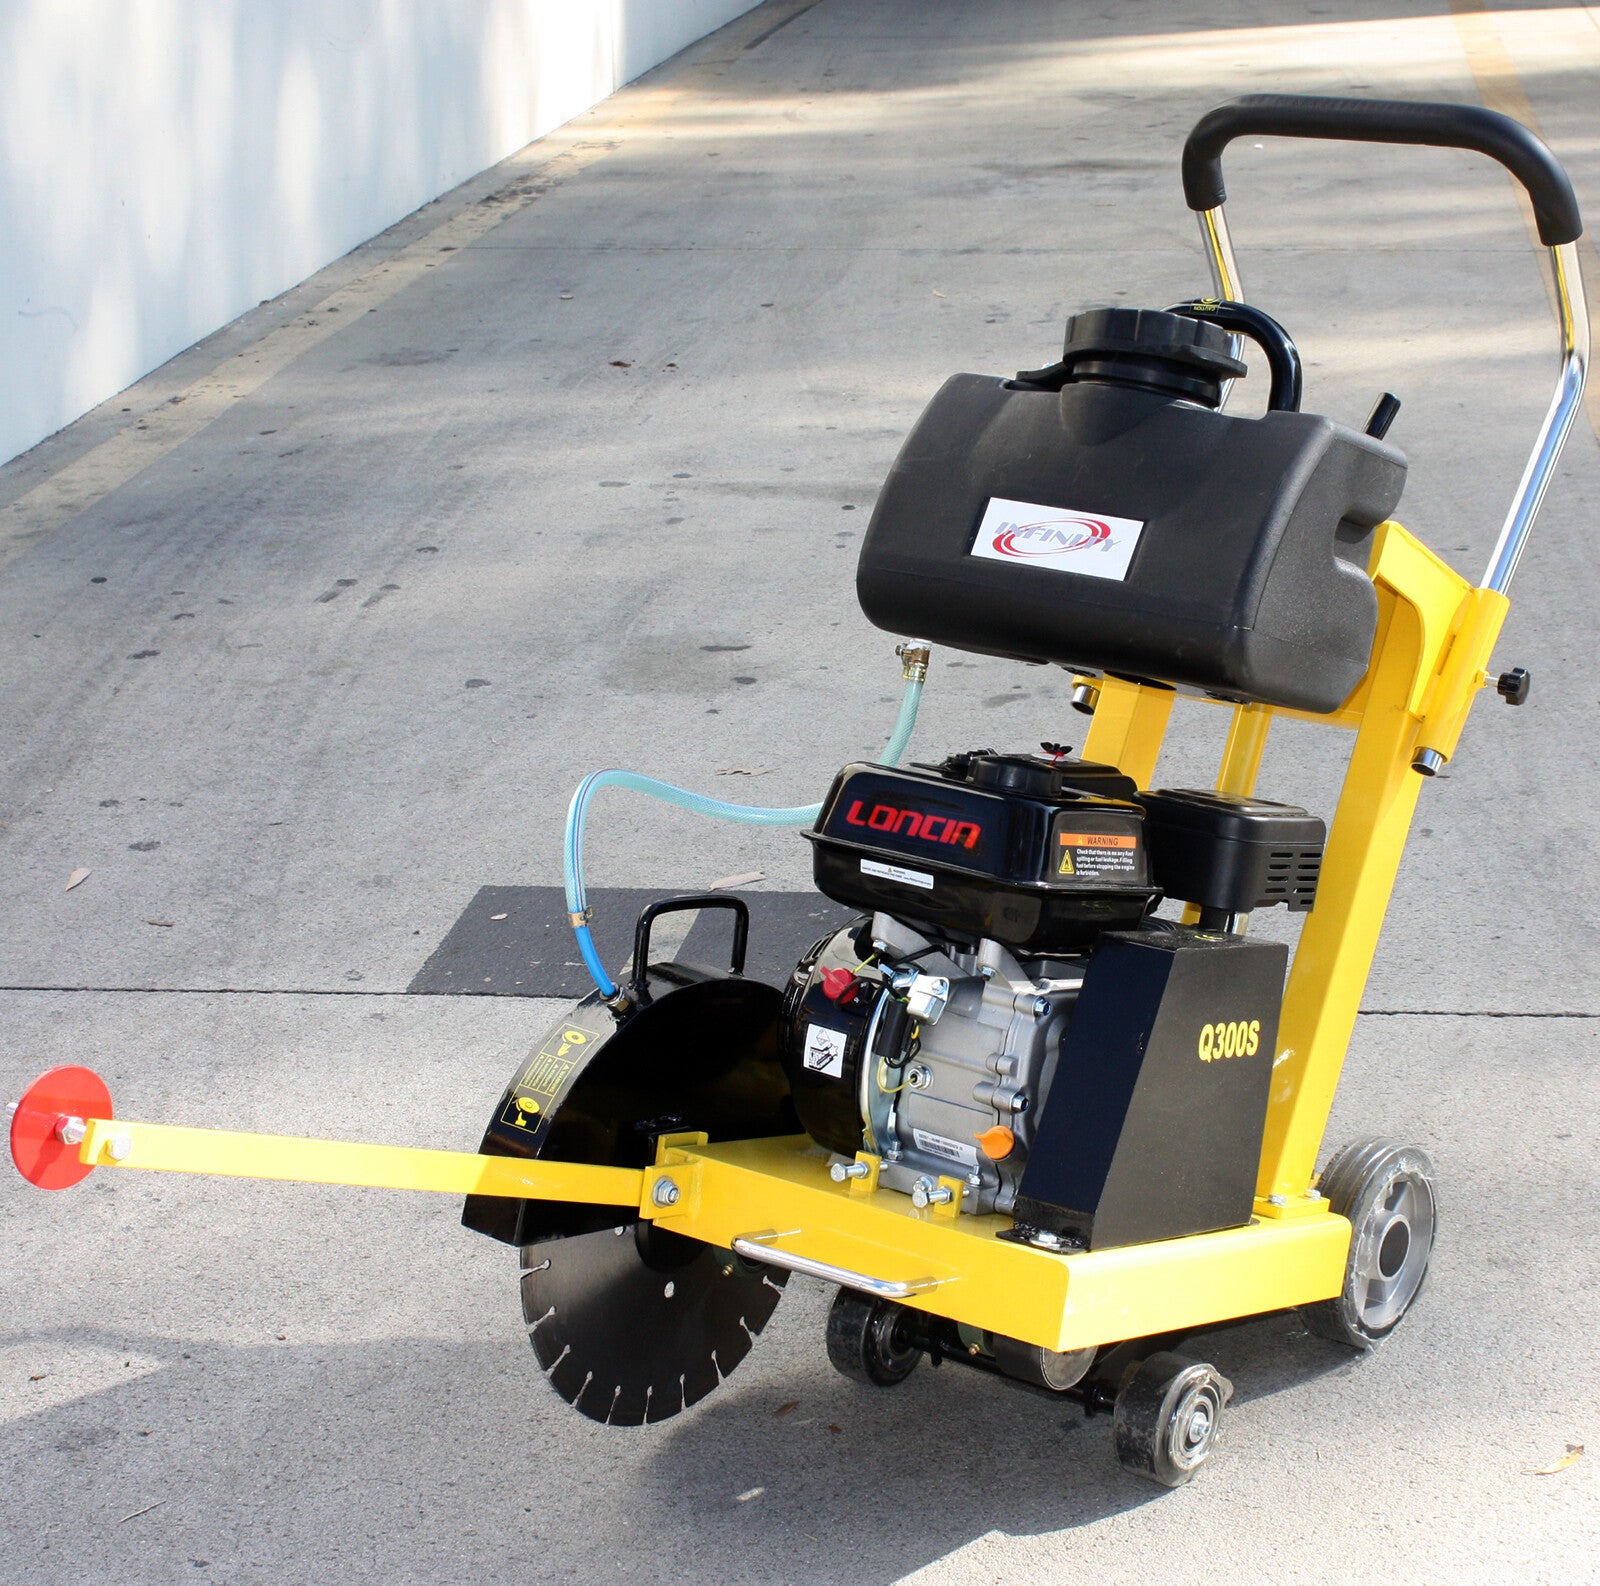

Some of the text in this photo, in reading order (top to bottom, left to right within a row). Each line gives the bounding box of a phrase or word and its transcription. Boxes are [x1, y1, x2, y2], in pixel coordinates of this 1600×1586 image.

[846, 800, 982, 848] LONCIN
[1087, 837, 1118, 846] WARNING
[1198, 1020, 1260, 1062] Q300S
